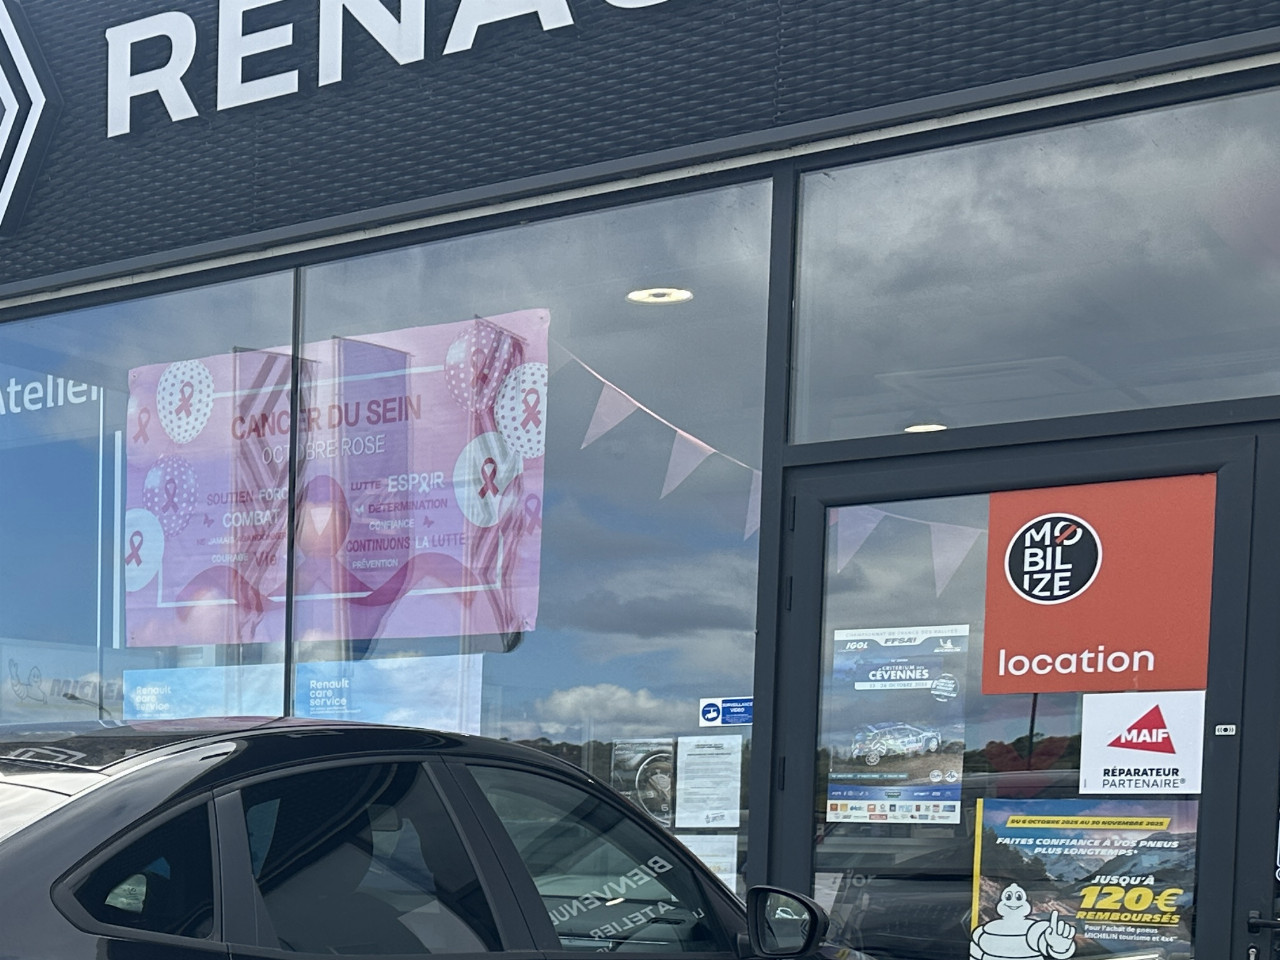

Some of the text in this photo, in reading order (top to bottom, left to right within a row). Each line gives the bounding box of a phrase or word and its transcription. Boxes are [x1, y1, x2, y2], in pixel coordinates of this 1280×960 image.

[231, 395, 422, 440] CANCER DU SEIN
[341, 434, 386, 457] ROSE
[350, 480, 382, 491] LUTTE
[207, 487, 288, 506] SOUTIEN FORC
[222, 508, 280, 528] COMBAT
[368, 519, 415, 531] CONFIANCE
[346, 533, 466, 553] CONTINUONS LA LUTTE
[211, 552, 249, 563] COURAGE
[352, 558, 399, 569] PRÉVENTION
[998, 645, 1155, 676] location
[868, 668, 929, 680] CÉVENNES
[310, 678, 350, 689] Renault
[136, 685, 172, 695] Renault
[310, 689, 333, 698] care
[310, 696, 347, 706] service
[1120, 728, 1169, 743] MAIF
[1103, 766, 1179, 777] RÉPARATEUR
[1035, 838, 1102, 847] CONFIANCE
[1103, 836, 1113, 846] À
[1114, 839, 1137, 847] VOS
[1139, 840, 1179, 849] PNEUS
[1079, 885, 1184, 912] 120€
[1075, 911, 1181, 923] REMBOURSÉS
